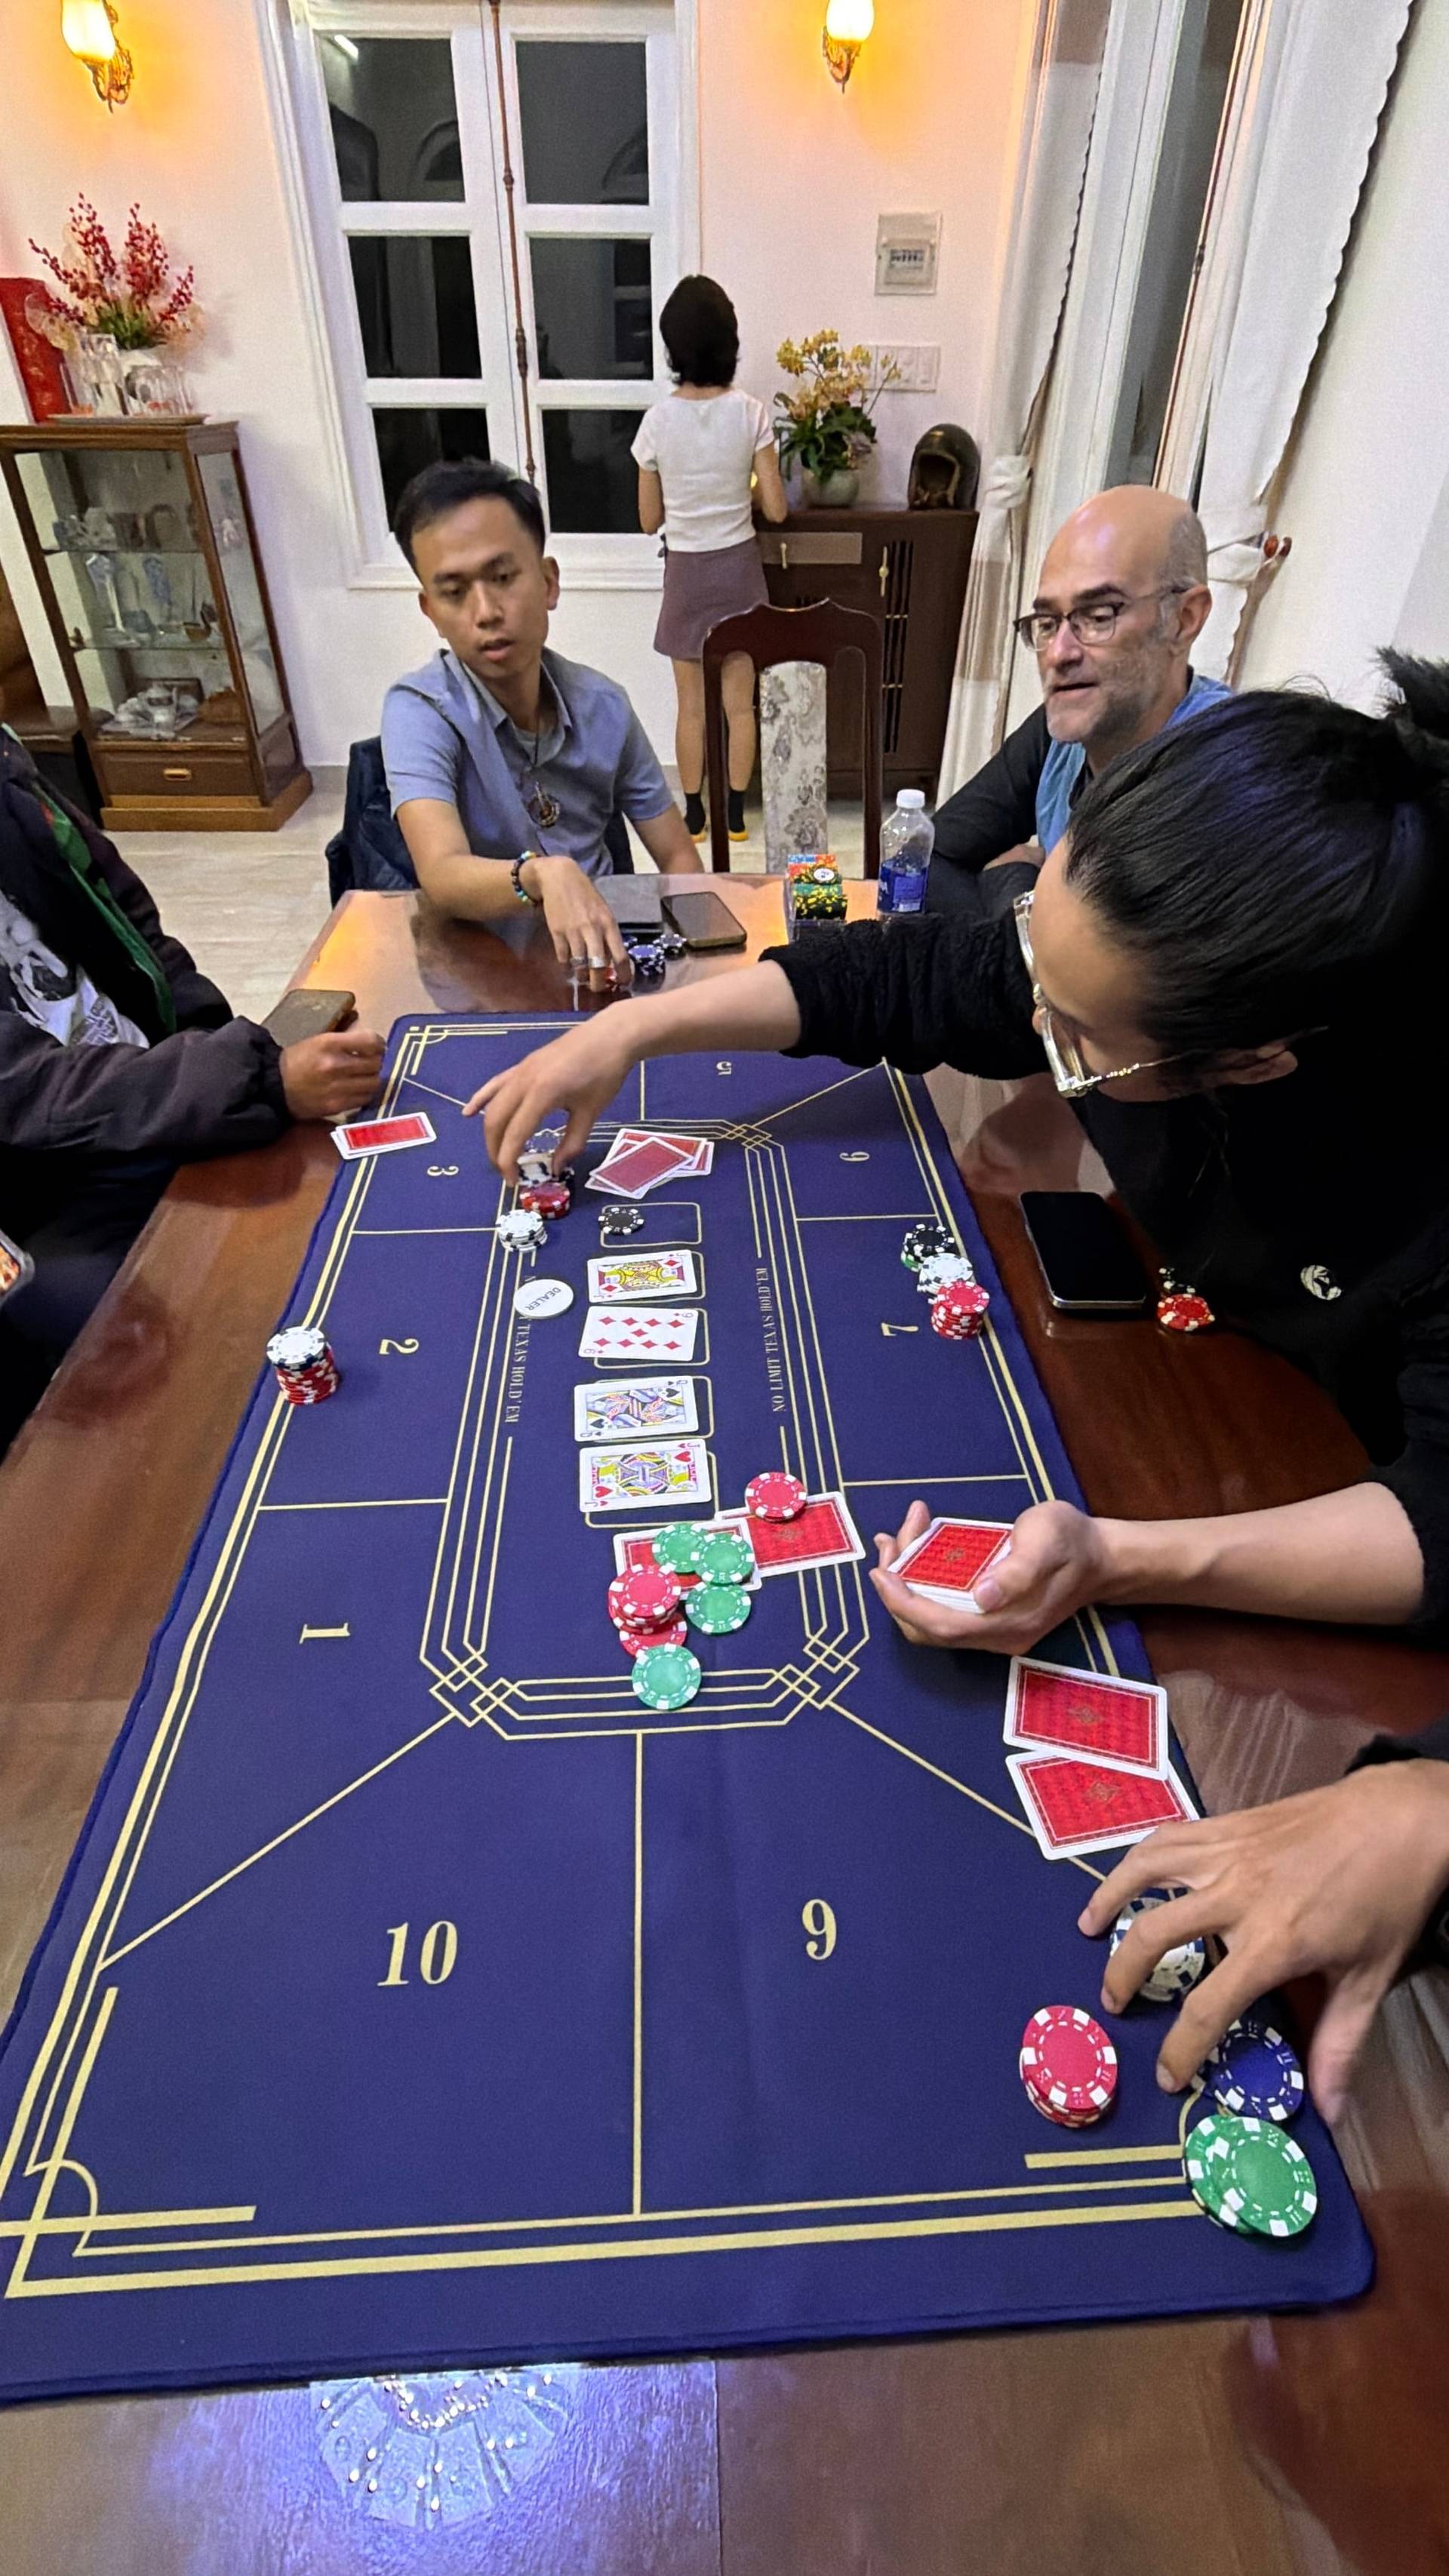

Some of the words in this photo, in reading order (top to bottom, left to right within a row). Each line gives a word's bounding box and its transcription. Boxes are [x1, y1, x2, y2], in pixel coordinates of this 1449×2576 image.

[716, 1061, 732, 1075] 5
[839, 1151, 870, 1162] 6
[427, 1165, 459, 1177] 3
[525, 1287, 561, 1310] DEALER
[763, 1316, 778, 1353] TEXAS
[881, 1322, 918, 1337] 7
[379, 1338, 419, 1355] 2
[514, 1324, 530, 1362] TEXAS
[767, 1358, 784, 1391] LIMIT
[772, 1395, 786, 1412] NO
[584, 1498, 598, 1507] J
[300, 1623, 350, 1644] 1
[801, 1898, 837, 1960] 9
[377, 1920, 457, 1987] 10
